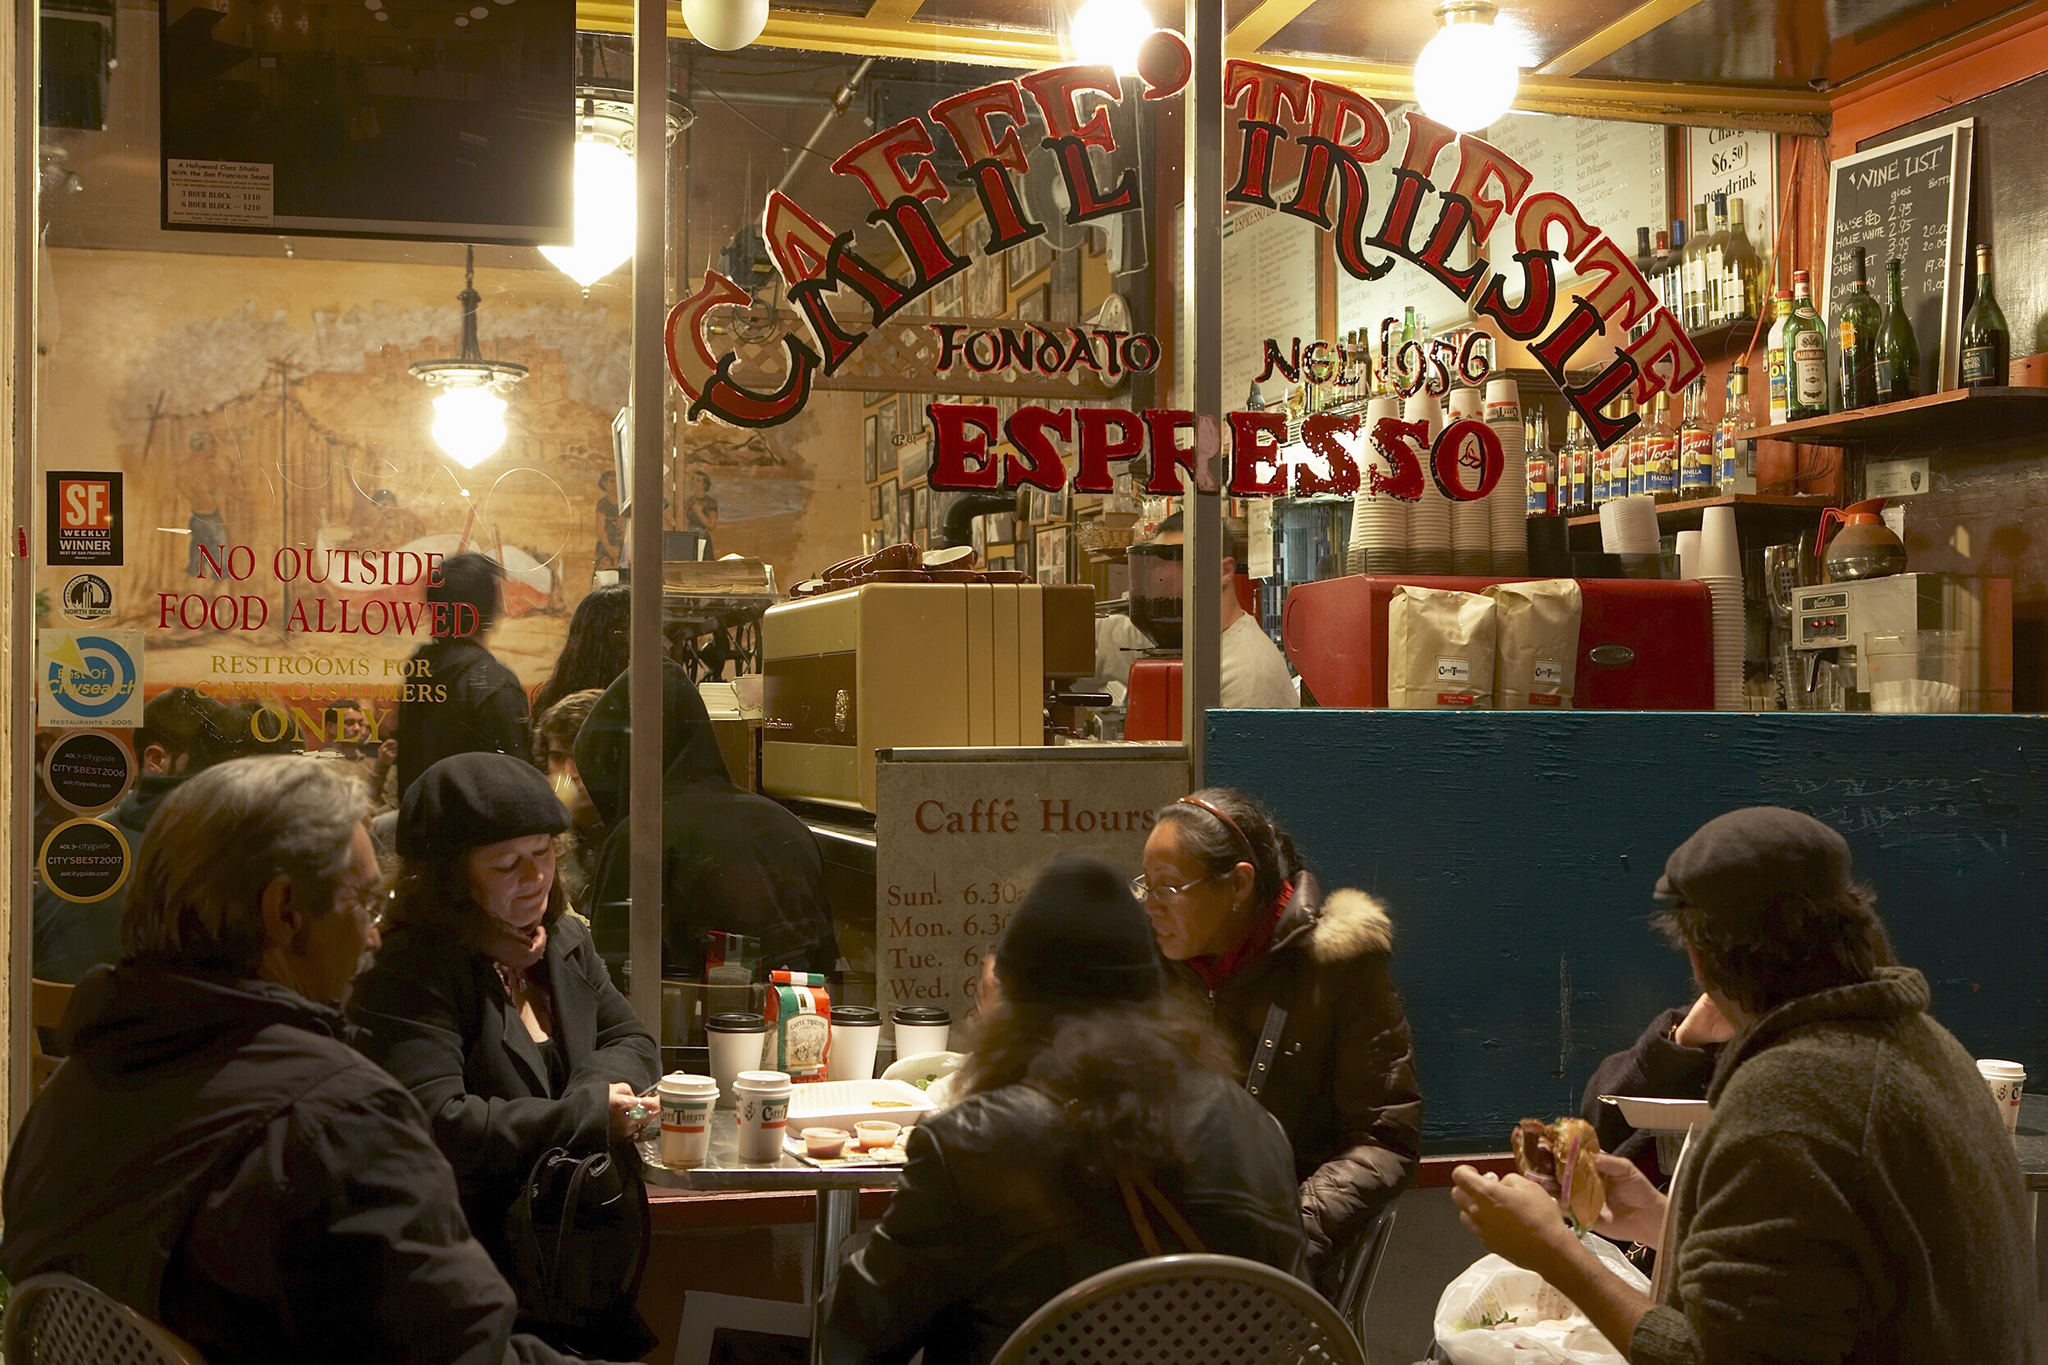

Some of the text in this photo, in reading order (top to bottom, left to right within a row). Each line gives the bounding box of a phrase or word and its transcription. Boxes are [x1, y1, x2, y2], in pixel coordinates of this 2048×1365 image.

[1576, 151, 1599, 167] Calistoga
[1712, 145, 1743, 175] $6.50
[1849, 145, 1944, 190] WINE LIST
[1576, 170, 1586, 181] San
[1586, 160, 1612, 177] Pellegrino
[1725, 170, 1757, 196] drink
[1890, 175, 1950, 204] glass BOTTL
[1865, 209, 1881, 226] RED
[1888, 202, 1913, 221] 2.95
[1889, 218, 1915, 237] 2.95
[1888, 237, 1910, 252] 3.95
[926, 401, 1505, 503] ESPRESSO
[66, 484, 105, 526] SF
[60, 540, 111, 550] WINNER
[196, 544, 446, 588] NO OUTSIDE
[157, 592, 480, 638] FOOD ALLOWED
[90, 668, 106, 679] Of
[210, 655, 433, 678] RESTROOMS FOR
[46, 679, 136, 698] Citysearch
[289, 682, 448, 703] CUSTOMERS
[250, 706, 392, 744] ONLY
[914, 798, 1155, 834] Caffé Hours
[887, 884, 943, 907] Sun.
[888, 916, 952, 938] Mon.
[888, 948, 943, 969] Tue.
[889, 978, 950, 1000] Wed.
[790, 1019, 826, 1030] CAFFE TRIESTE
[674, 1109, 705, 1125] TRIESTE
[762, 1106, 783, 1121] CAFFE
